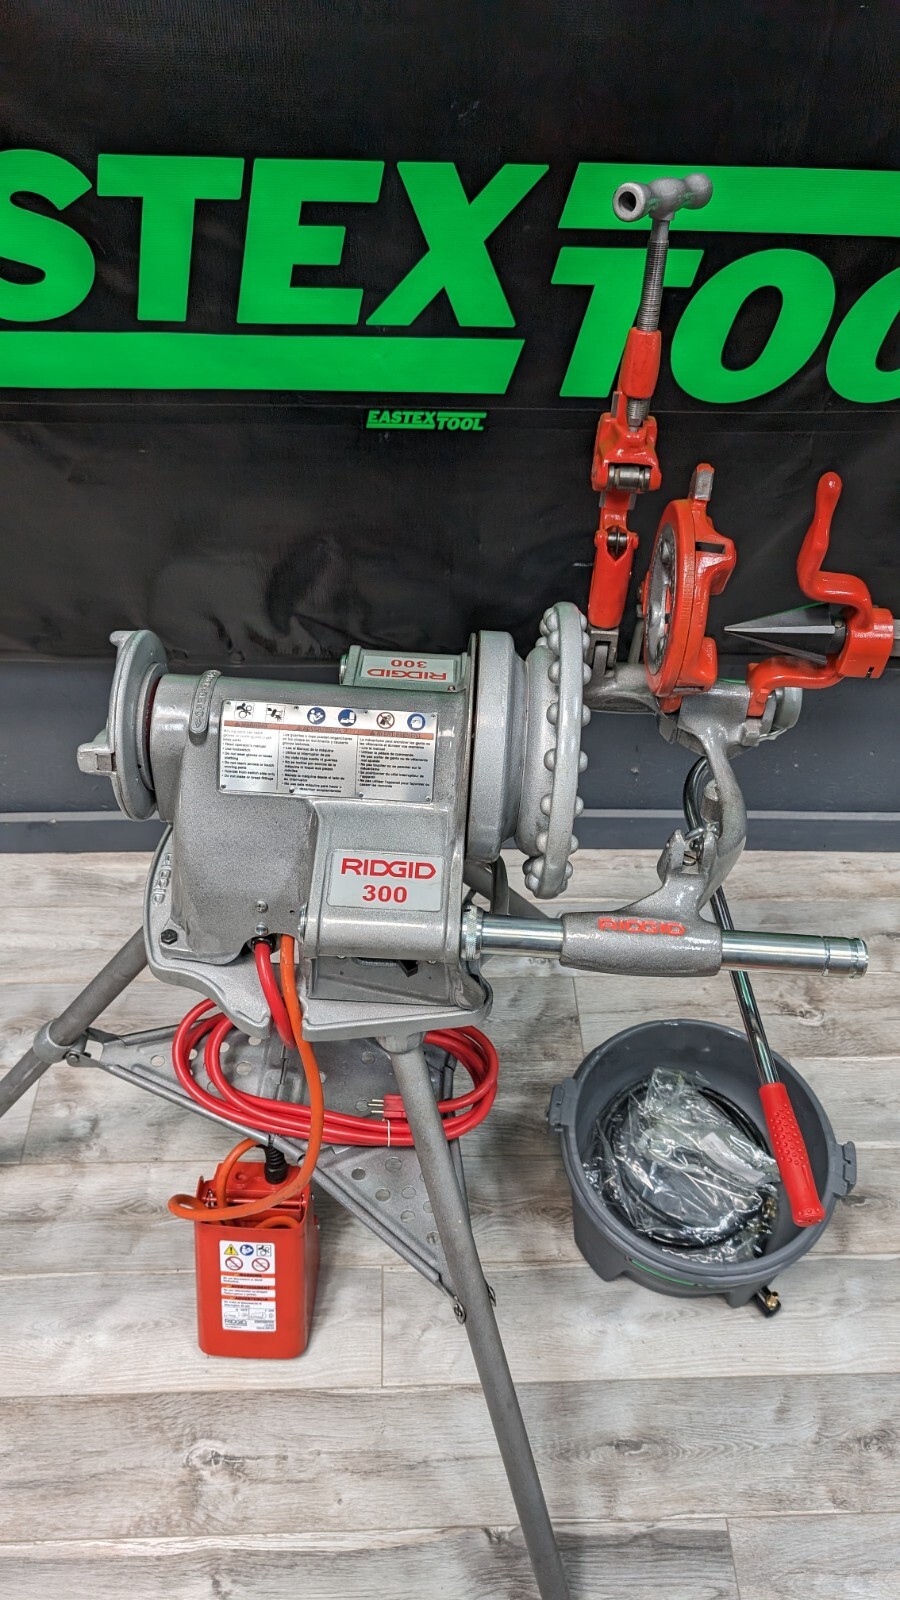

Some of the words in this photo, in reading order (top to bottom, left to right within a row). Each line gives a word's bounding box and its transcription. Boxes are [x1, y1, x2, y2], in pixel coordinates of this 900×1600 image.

[368, 409, 437, 424] EASTEX
[437, 417, 485, 431] TOOL
[391, 659, 427, 668] 300
[367, 668, 446, 681] RIDGID
[341, 858, 437, 879] RIDGID
[362, 885, 408, 903] 300
[597, 917, 686, 936] RIDGID
